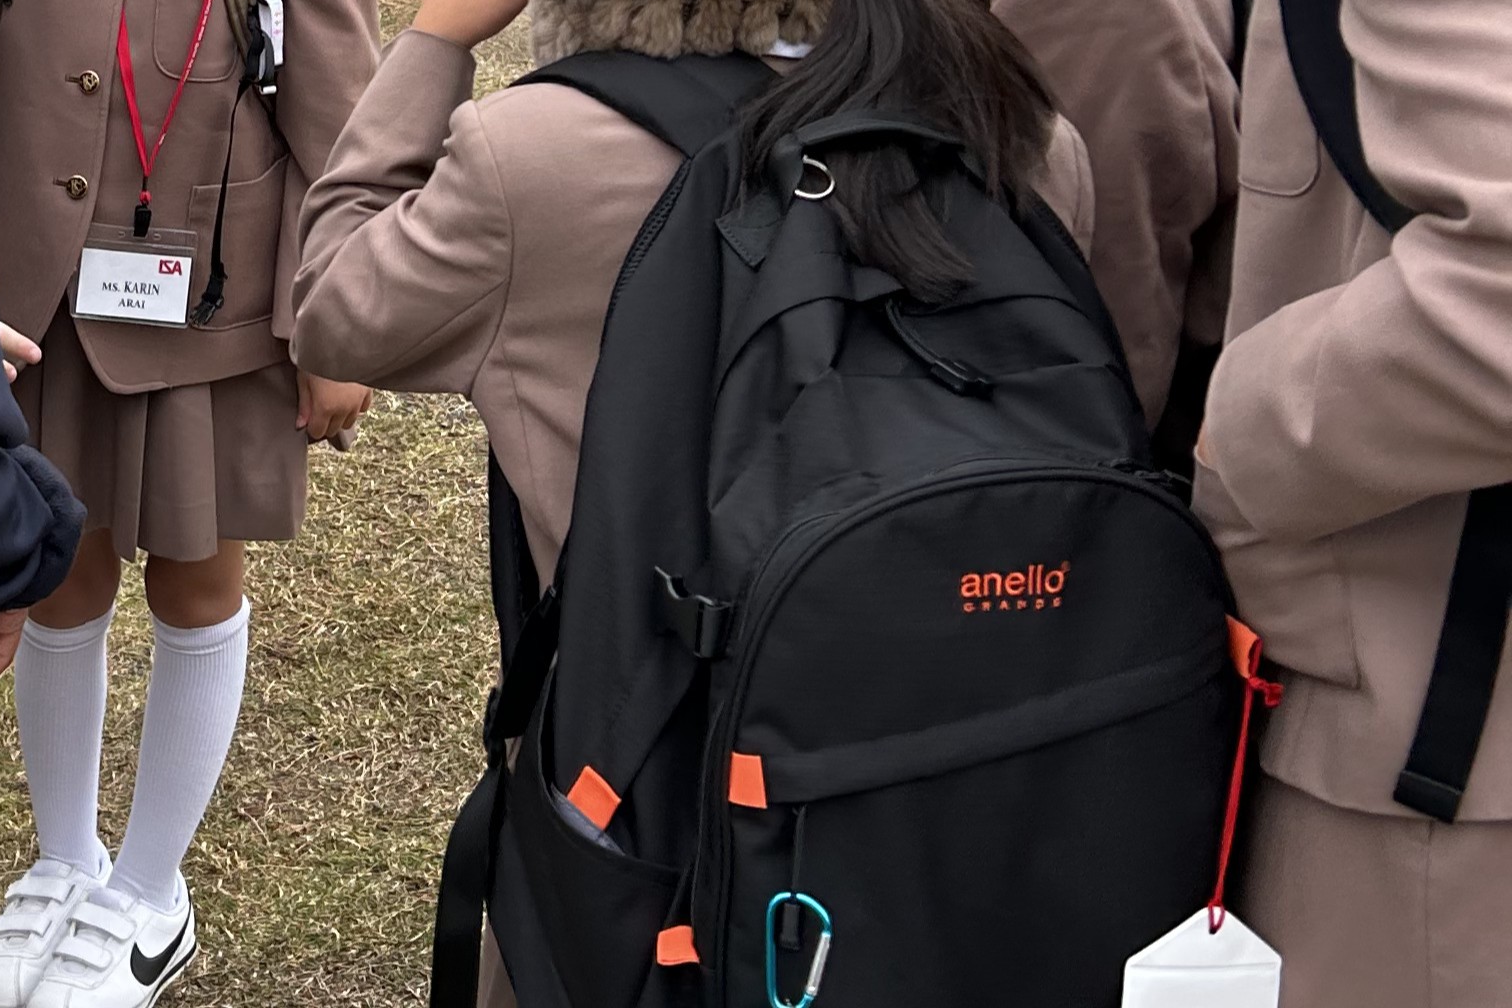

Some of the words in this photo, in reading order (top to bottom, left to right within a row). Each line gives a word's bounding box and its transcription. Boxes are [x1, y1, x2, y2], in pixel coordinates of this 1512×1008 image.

[124, 280, 160, 296] KARIN
[118, 297, 145, 309] ARAI
[961, 563, 1065, 598] anello
